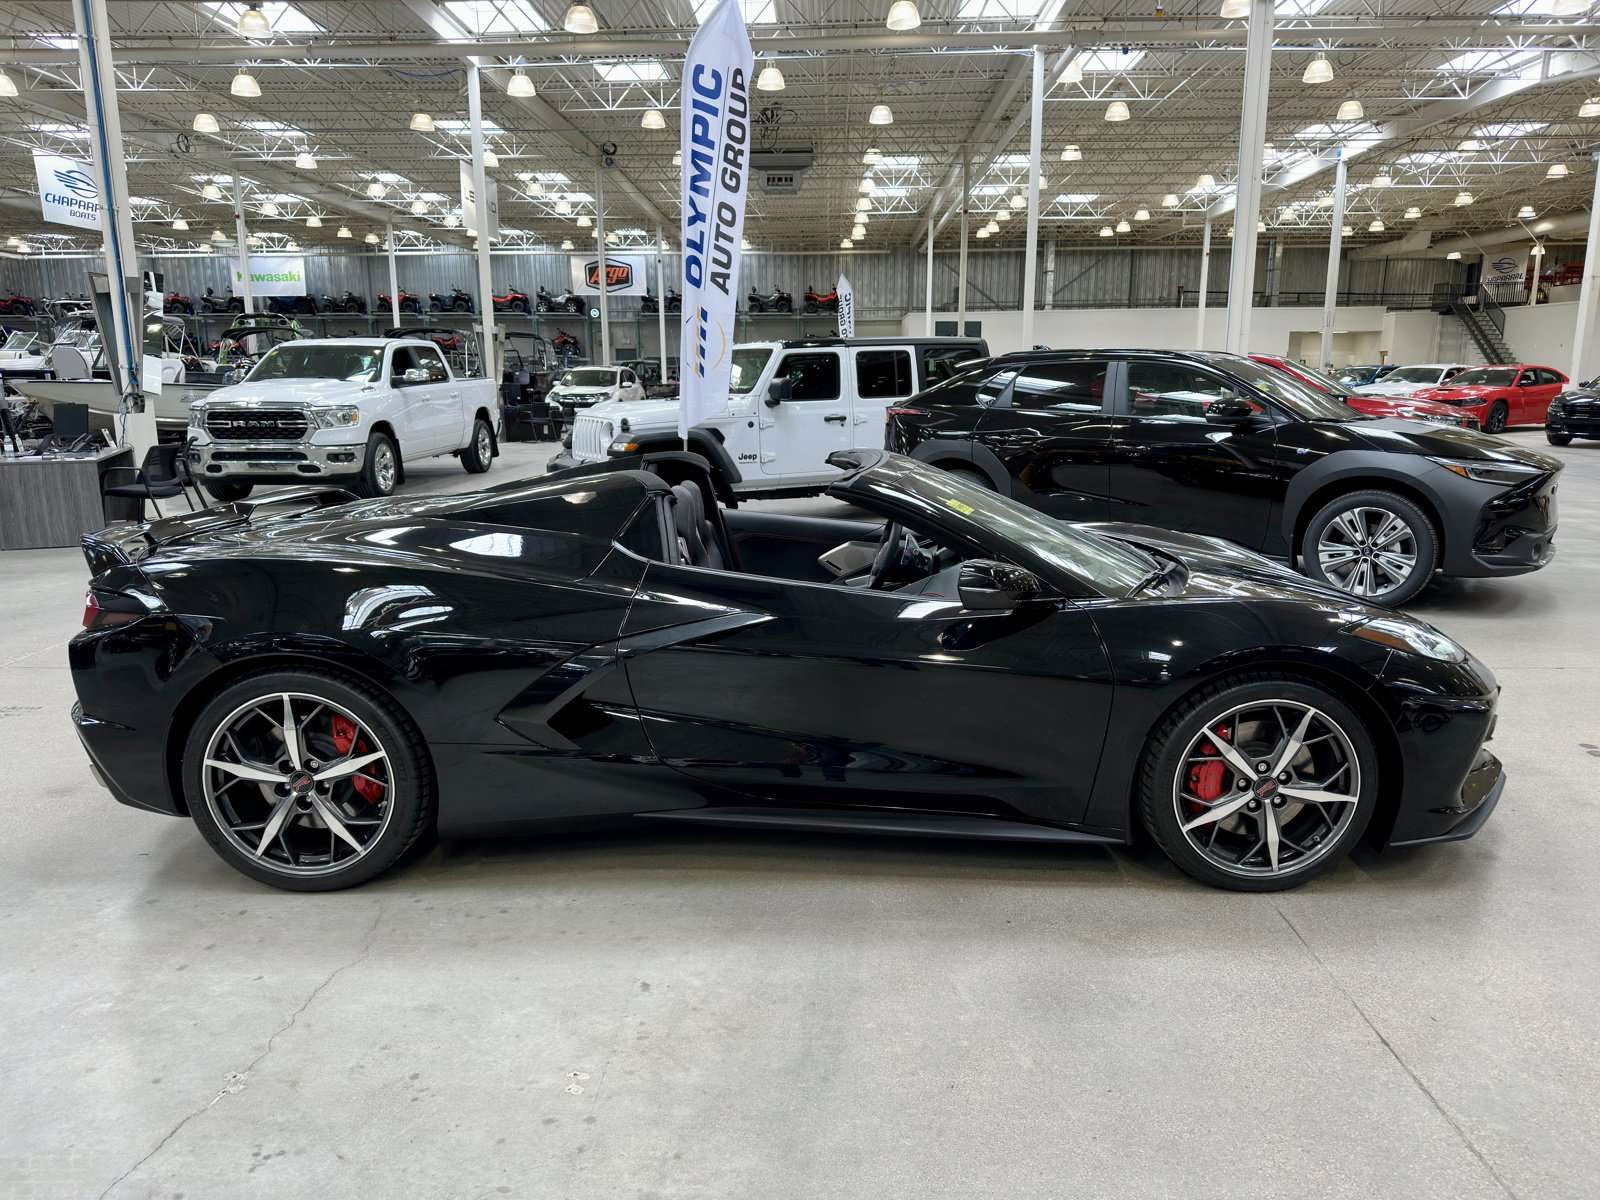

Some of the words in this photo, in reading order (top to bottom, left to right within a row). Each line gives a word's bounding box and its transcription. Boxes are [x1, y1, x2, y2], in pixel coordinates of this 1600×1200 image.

[720, 67, 747, 194] GROUP
[685, 63, 722, 289] OLYMPIC
[44, 192, 101, 213] CHAPARR
[69, 209, 97, 221] BOATS
[710, 201, 737, 296] AUTO
[232, 420, 276, 428] RAM
[737, 452, 758, 461] Jeep
